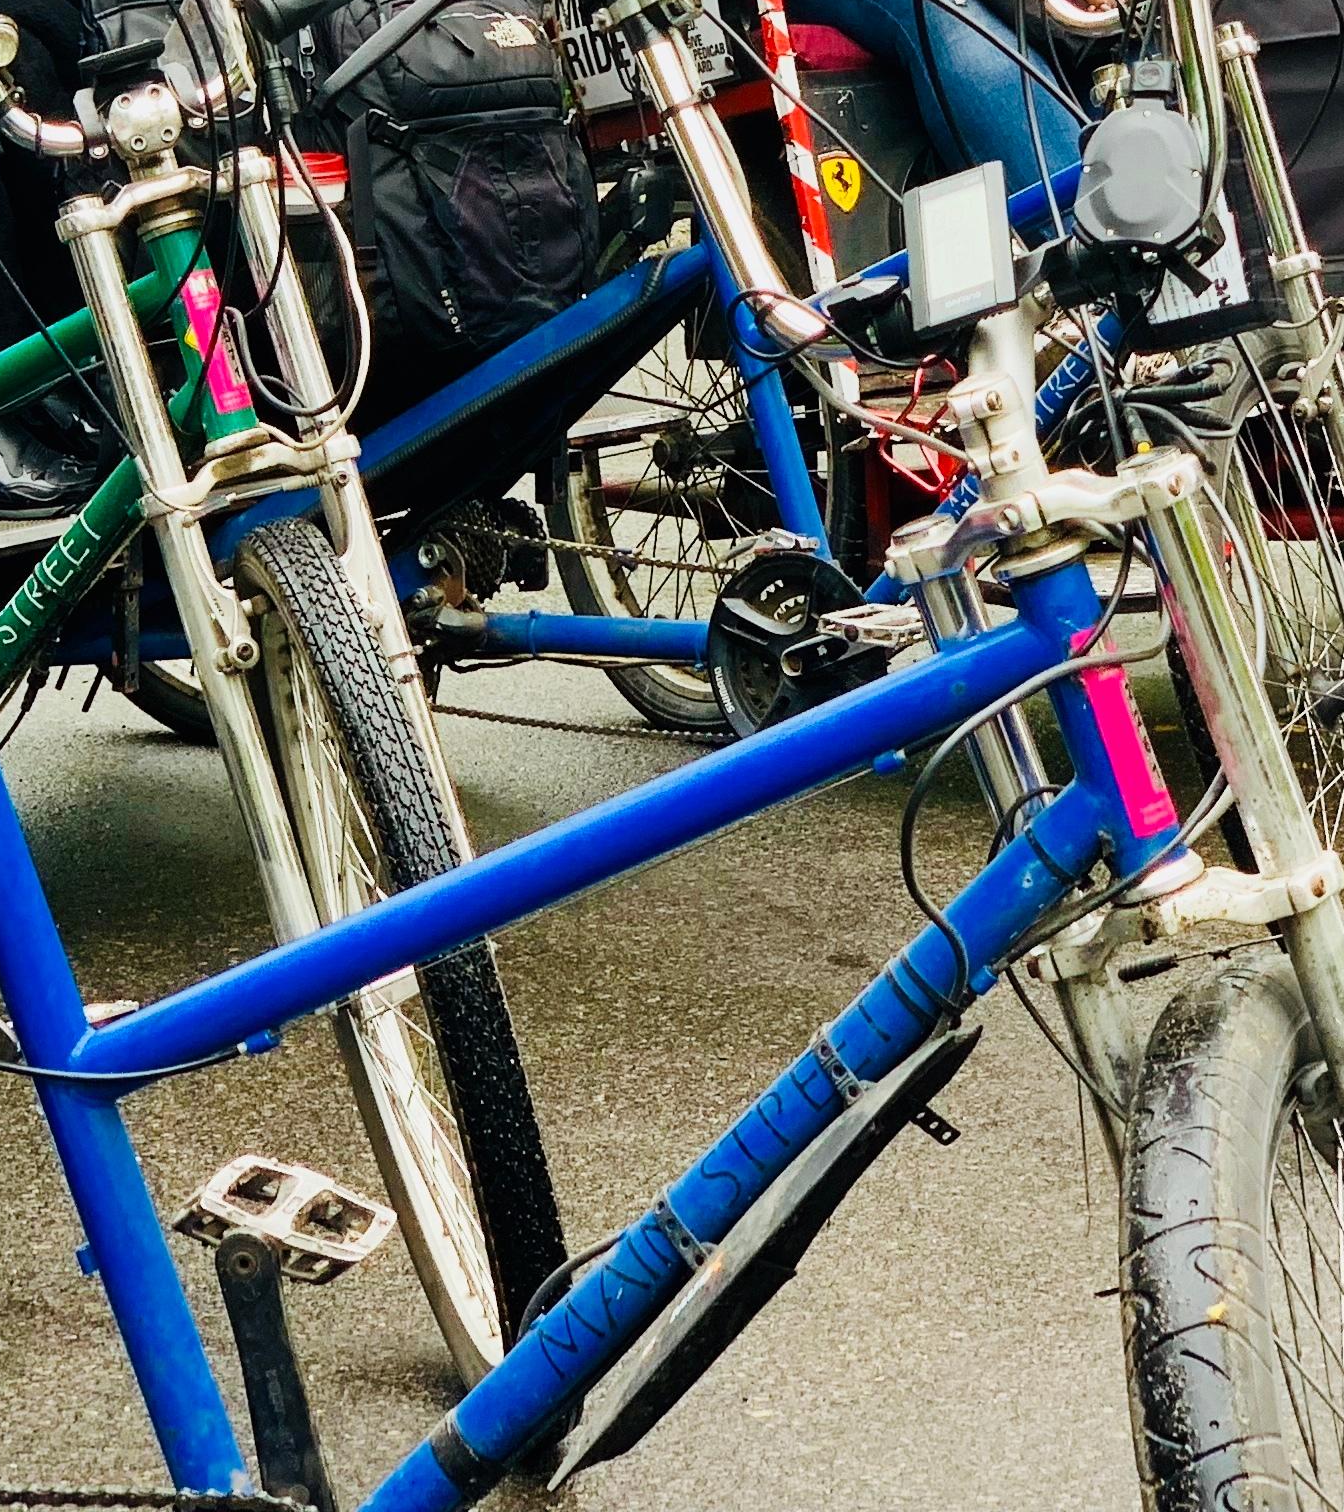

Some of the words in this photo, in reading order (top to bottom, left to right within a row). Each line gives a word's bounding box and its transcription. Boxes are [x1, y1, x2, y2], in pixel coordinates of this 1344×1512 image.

[563, 27, 632, 81] RIDE
[692, 42, 725, 62] PEDICAB
[440, 289, 462, 333] RECON
